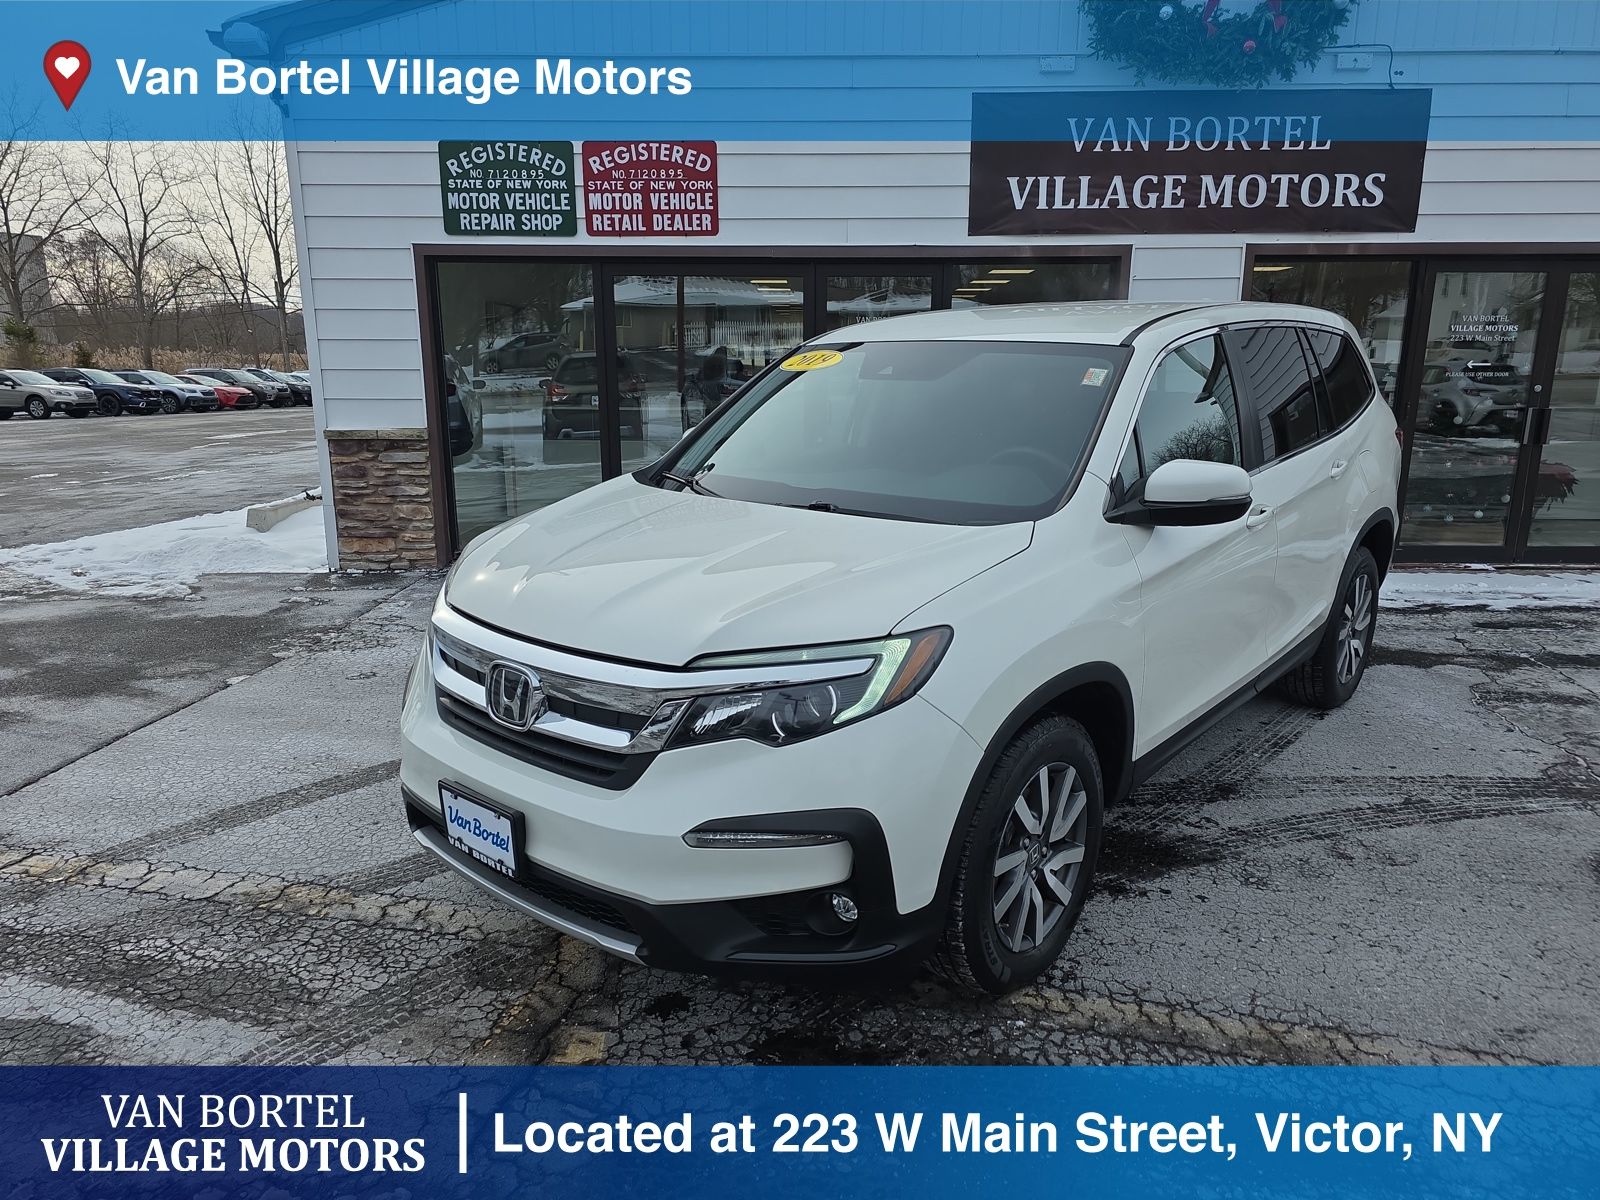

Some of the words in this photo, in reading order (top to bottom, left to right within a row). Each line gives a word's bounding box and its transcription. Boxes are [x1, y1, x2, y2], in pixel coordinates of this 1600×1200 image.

[1067, 117, 1153, 152] VAN
[1166, 115, 1331, 151] BORTEL
[446, 142, 566, 176] REGISTERED
[588, 143, 711, 174] REGISTERED
[488, 169, 544, 178] 7120895
[612, 170, 627, 178] NO.
[630, 169, 684, 178] 7120895
[448, 180, 483, 188] STATE
[487, 180, 502, 188] OF
[506, 180, 532, 188] NEW
[536, 181, 567, 189] YORK
[588, 181, 624, 190] STATE
[629, 181, 645, 190] OF
[650, 181, 676, 190] NEW
[681, 181, 713, 190] YORK
[1006, 175, 1187, 210] VILLAGE
[1197, 173, 1386, 208] MOTORS
[448, 192, 500, 210] MOTOR
[505, 193, 571, 210] VEHICLE
[588, 192, 643, 210] MOTOR
[650, 192, 714, 210] VEHICLE
[460, 213, 516, 230] REPAIR
[521, 213, 563, 230] SHOP
[592, 214, 647, 231] RETAIL
[652, 214, 712, 231] DEALER
[1451, 324, 1483, 332] VILLAGE
[1485, 324, 1519, 332] MOTORS
[786, 353, 837, 367] 2019
[447, 835, 469, 854] VAN
